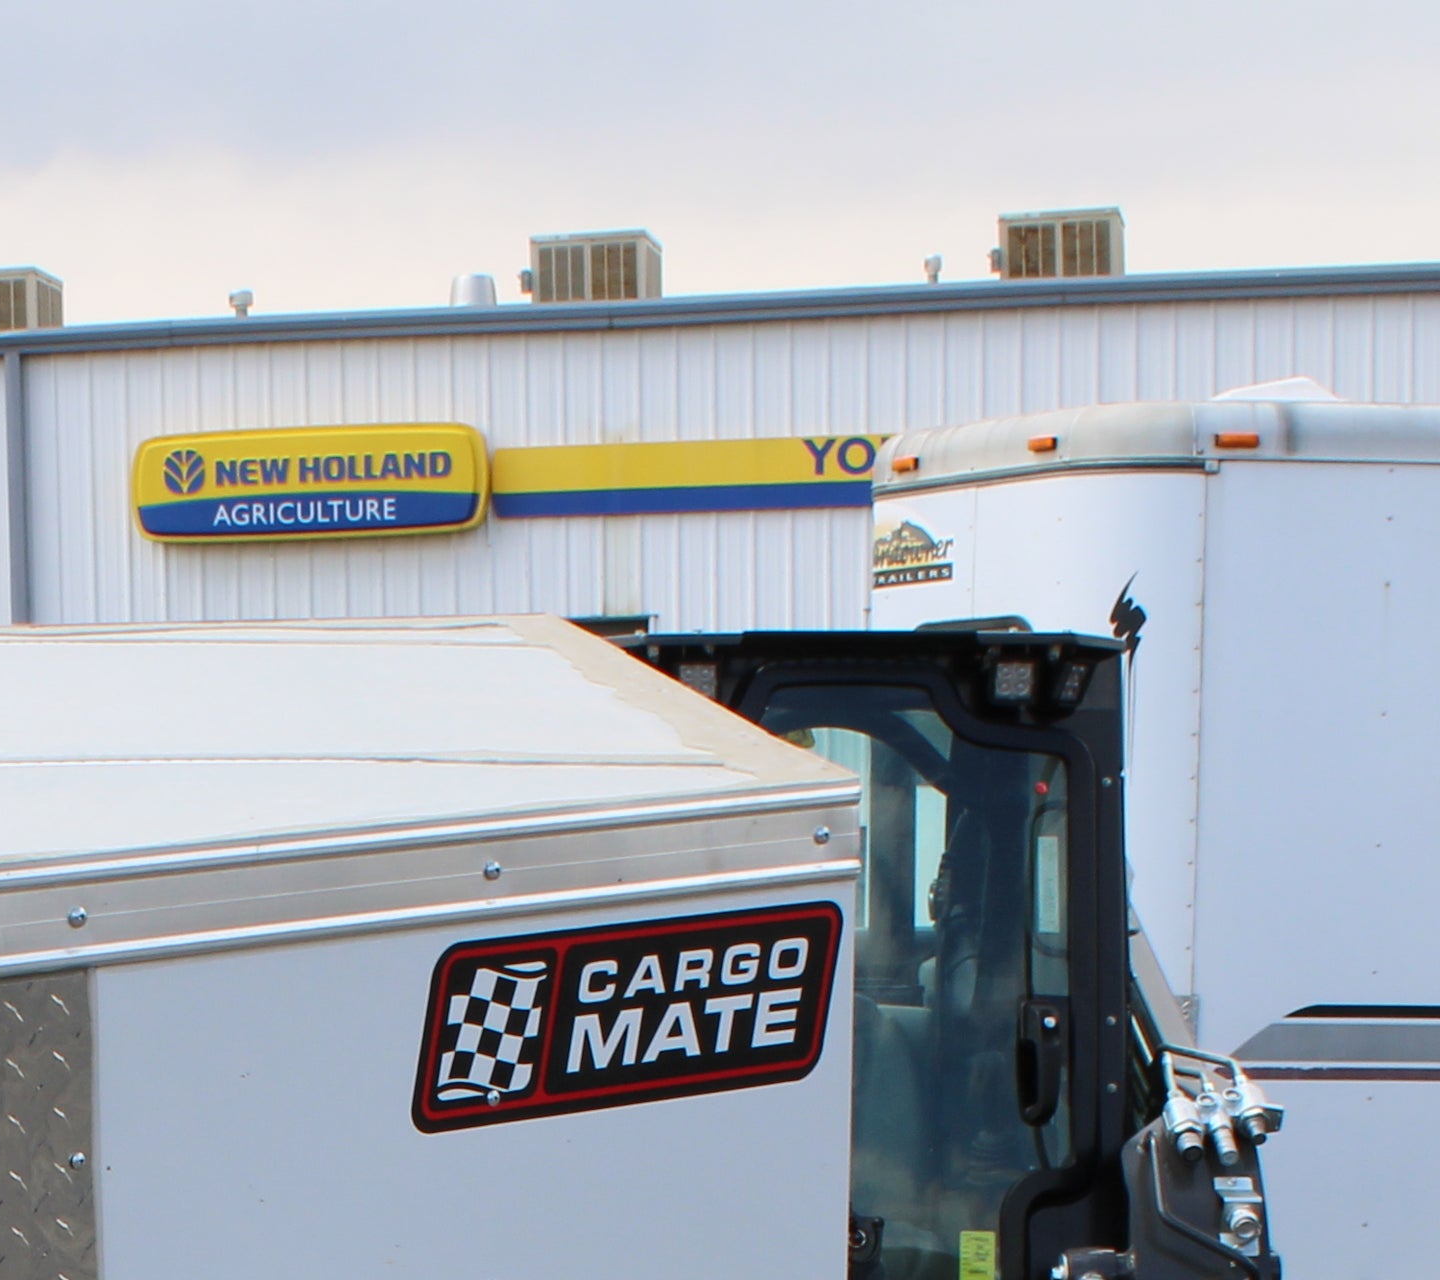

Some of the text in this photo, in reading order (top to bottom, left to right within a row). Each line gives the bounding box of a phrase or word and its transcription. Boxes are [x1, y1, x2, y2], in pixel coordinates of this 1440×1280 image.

[215, 450, 452, 487] NEW HOLLAND
[802, 437, 889, 476] YO
[212, 498, 397, 527] AGRICULTURE
[874, 566, 950, 585] RAILERS
[578, 937, 810, 1004] CARGO
[566, 987, 803, 1074] MATE
